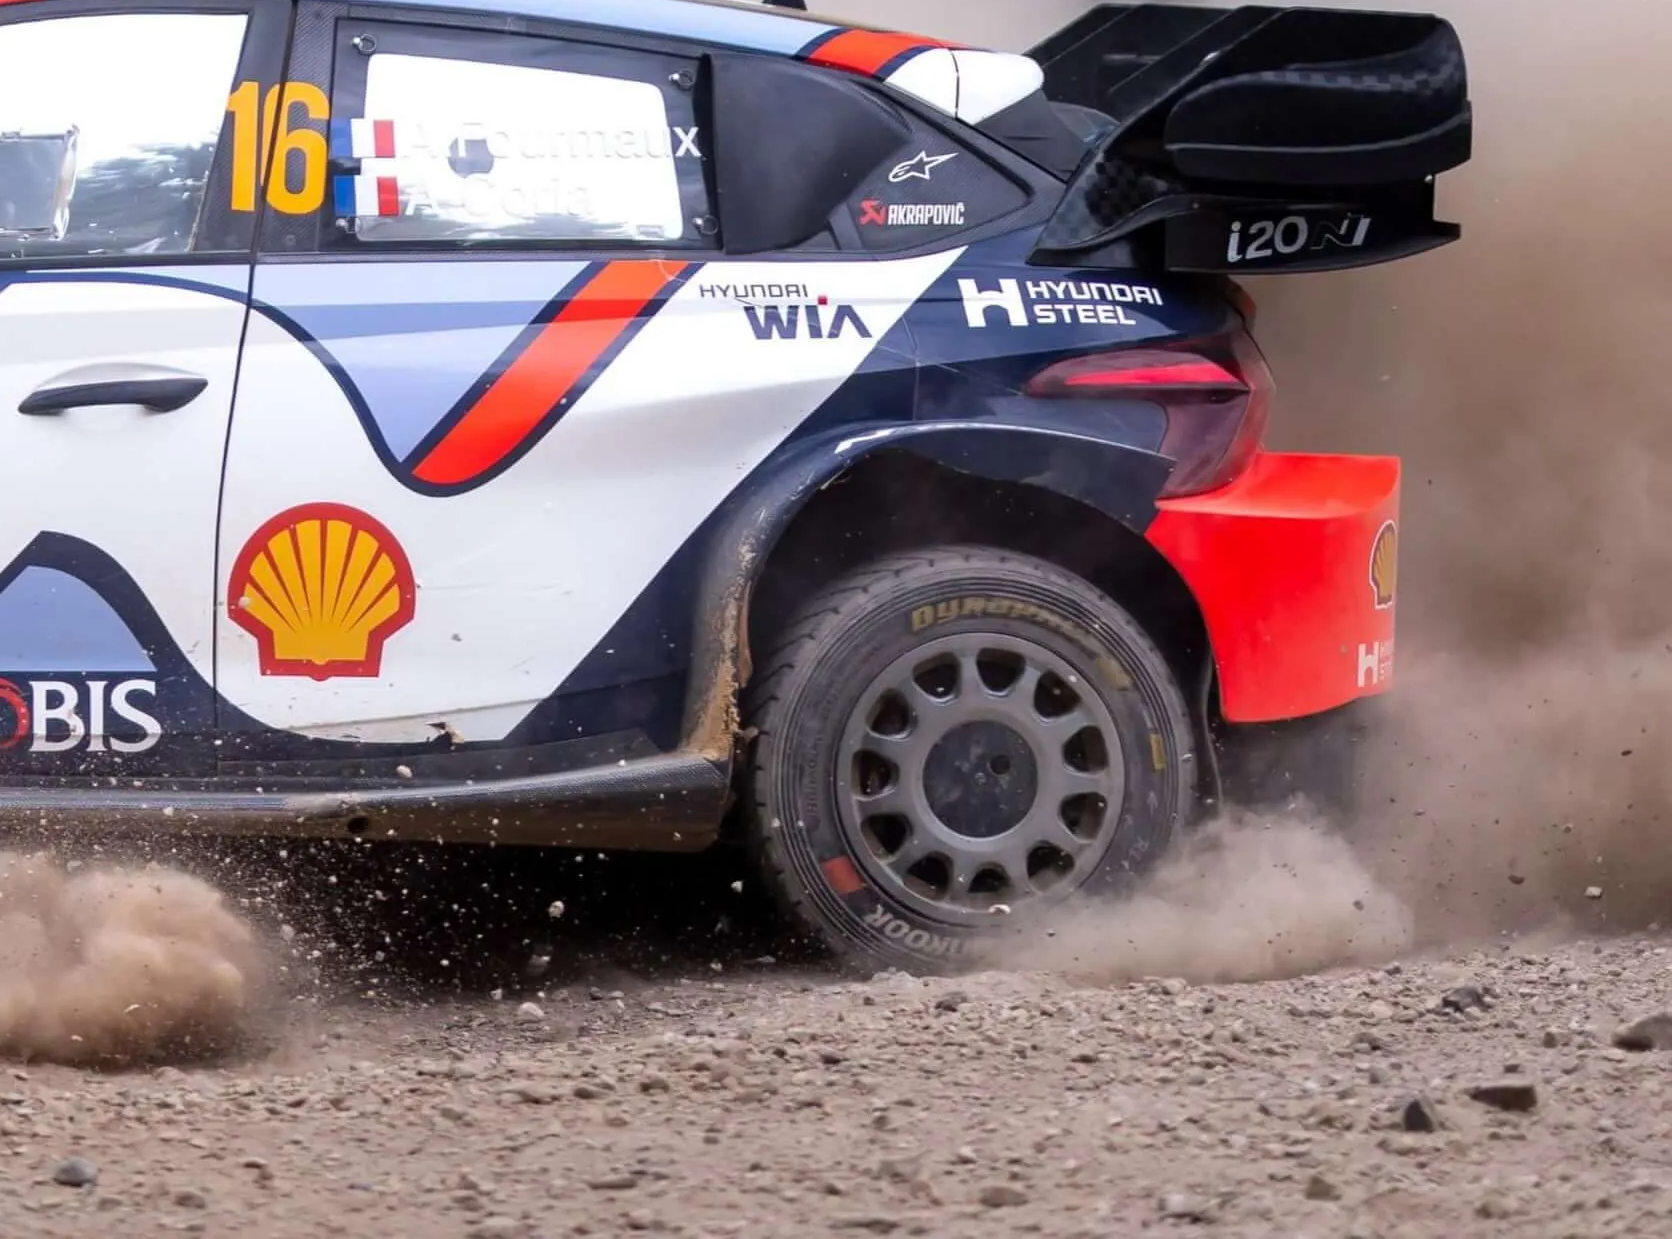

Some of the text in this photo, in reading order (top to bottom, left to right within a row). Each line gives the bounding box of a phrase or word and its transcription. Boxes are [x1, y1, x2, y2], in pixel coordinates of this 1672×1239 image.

[228, 80, 329, 215] 16
[700, 284, 809, 298] HYUNDAI
[1026, 280, 1164, 306] HYUNDAI
[743, 296, 873, 340] WIA
[1034, 304, 1137, 325] STEEL
